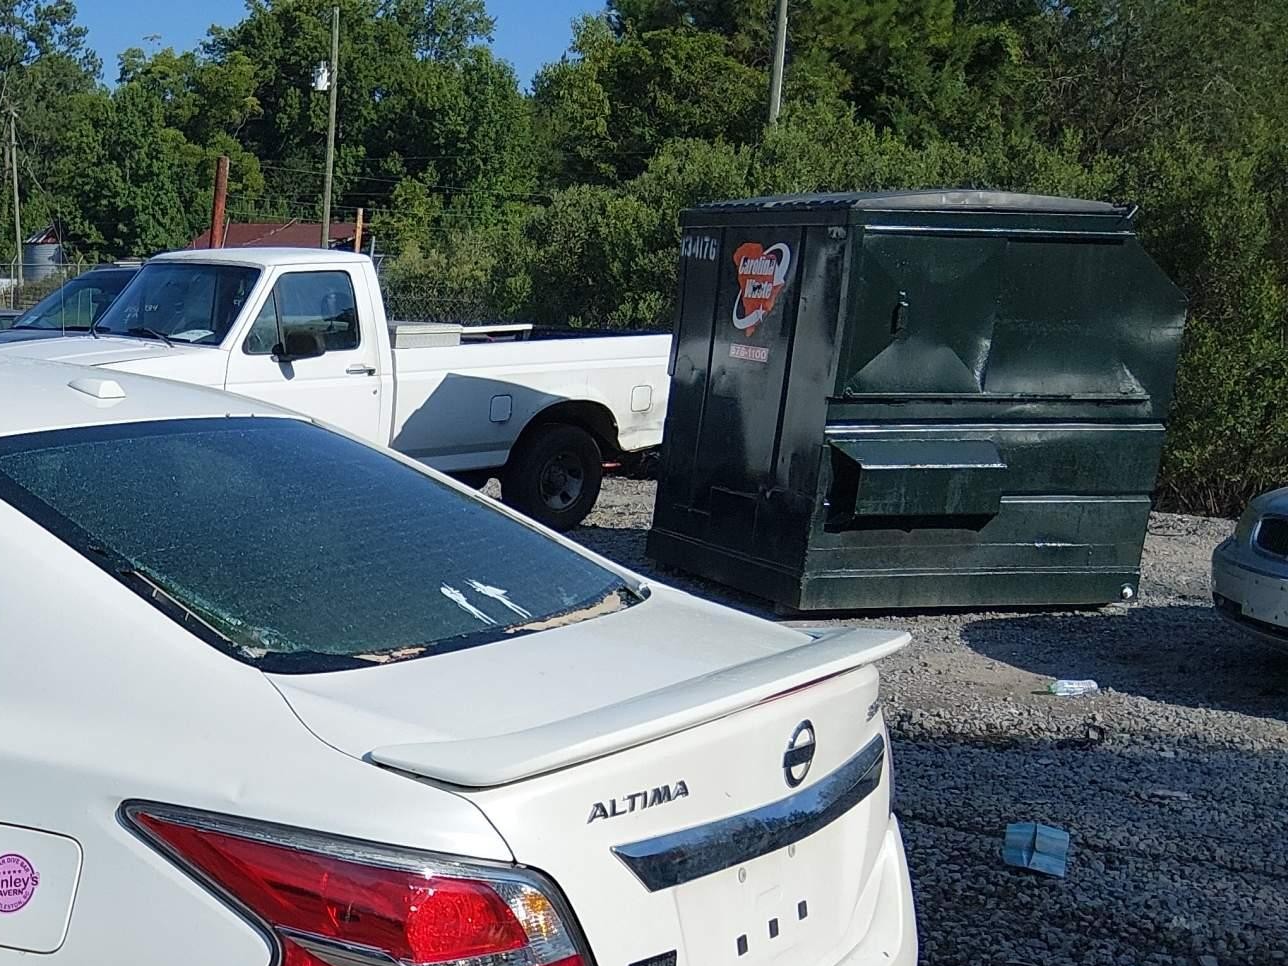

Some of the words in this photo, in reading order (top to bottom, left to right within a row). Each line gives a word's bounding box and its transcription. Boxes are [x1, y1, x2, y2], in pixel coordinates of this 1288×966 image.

[738, 252, 776, 275] Carolina
[743, 278, 773, 300] Waste
[586, 779, 690, 825] ALTIMA
